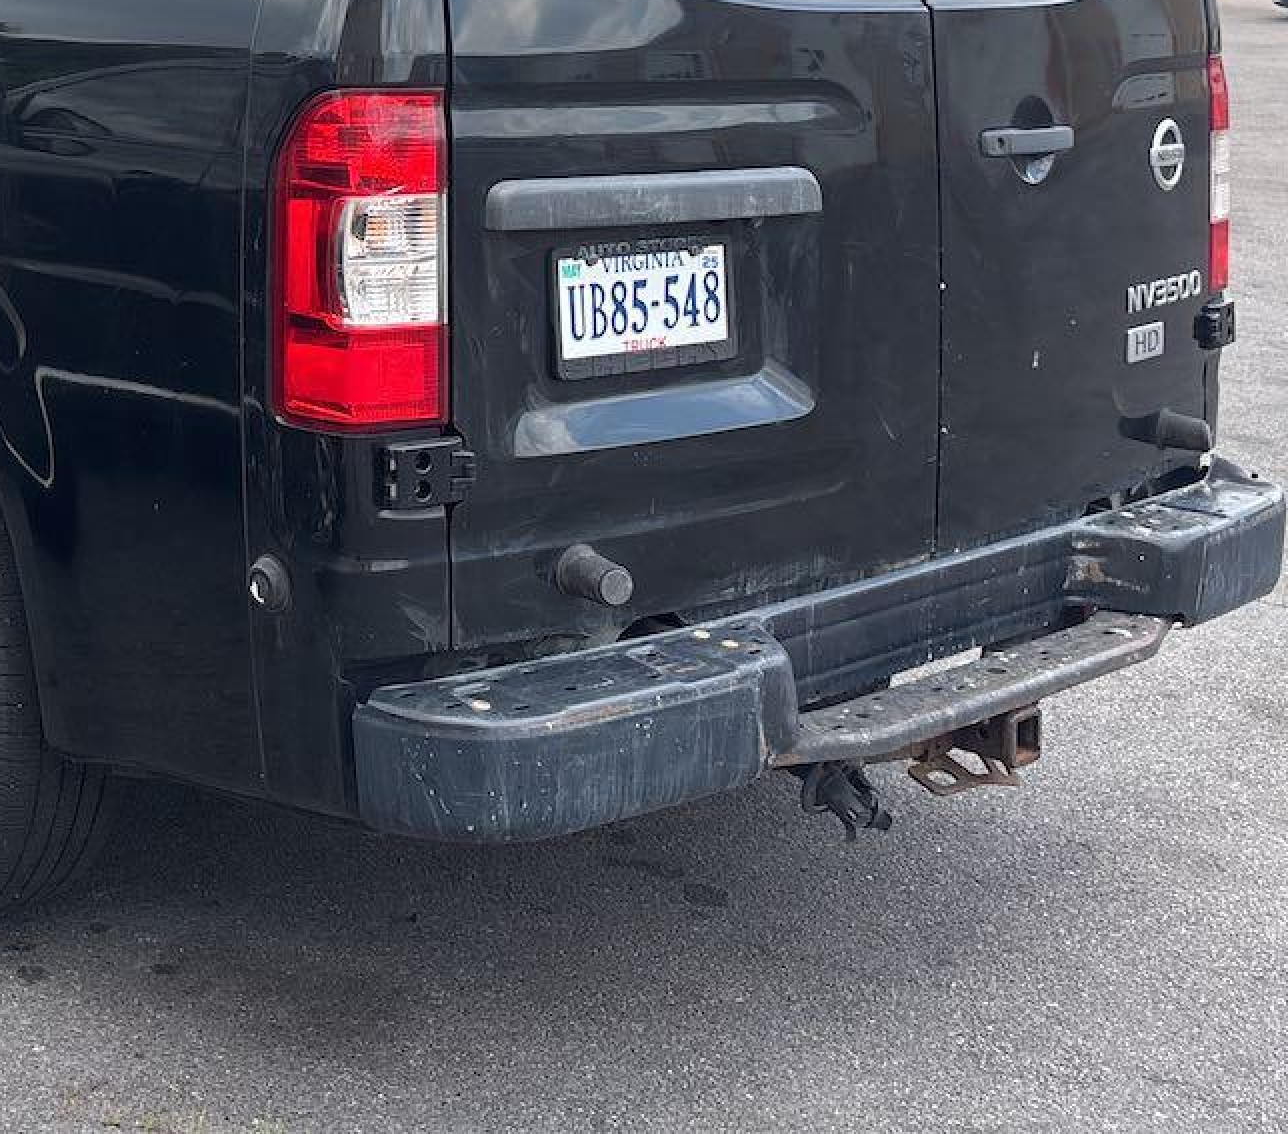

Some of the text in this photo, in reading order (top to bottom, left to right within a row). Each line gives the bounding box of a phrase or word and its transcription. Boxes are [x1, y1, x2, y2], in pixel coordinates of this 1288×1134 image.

[602, 251, 685, 273] VIRGINIA
[567, 270, 721, 341] UB85-548
[622, 336, 667, 353] TRUCK
[1134, 329, 1161, 356] HD
